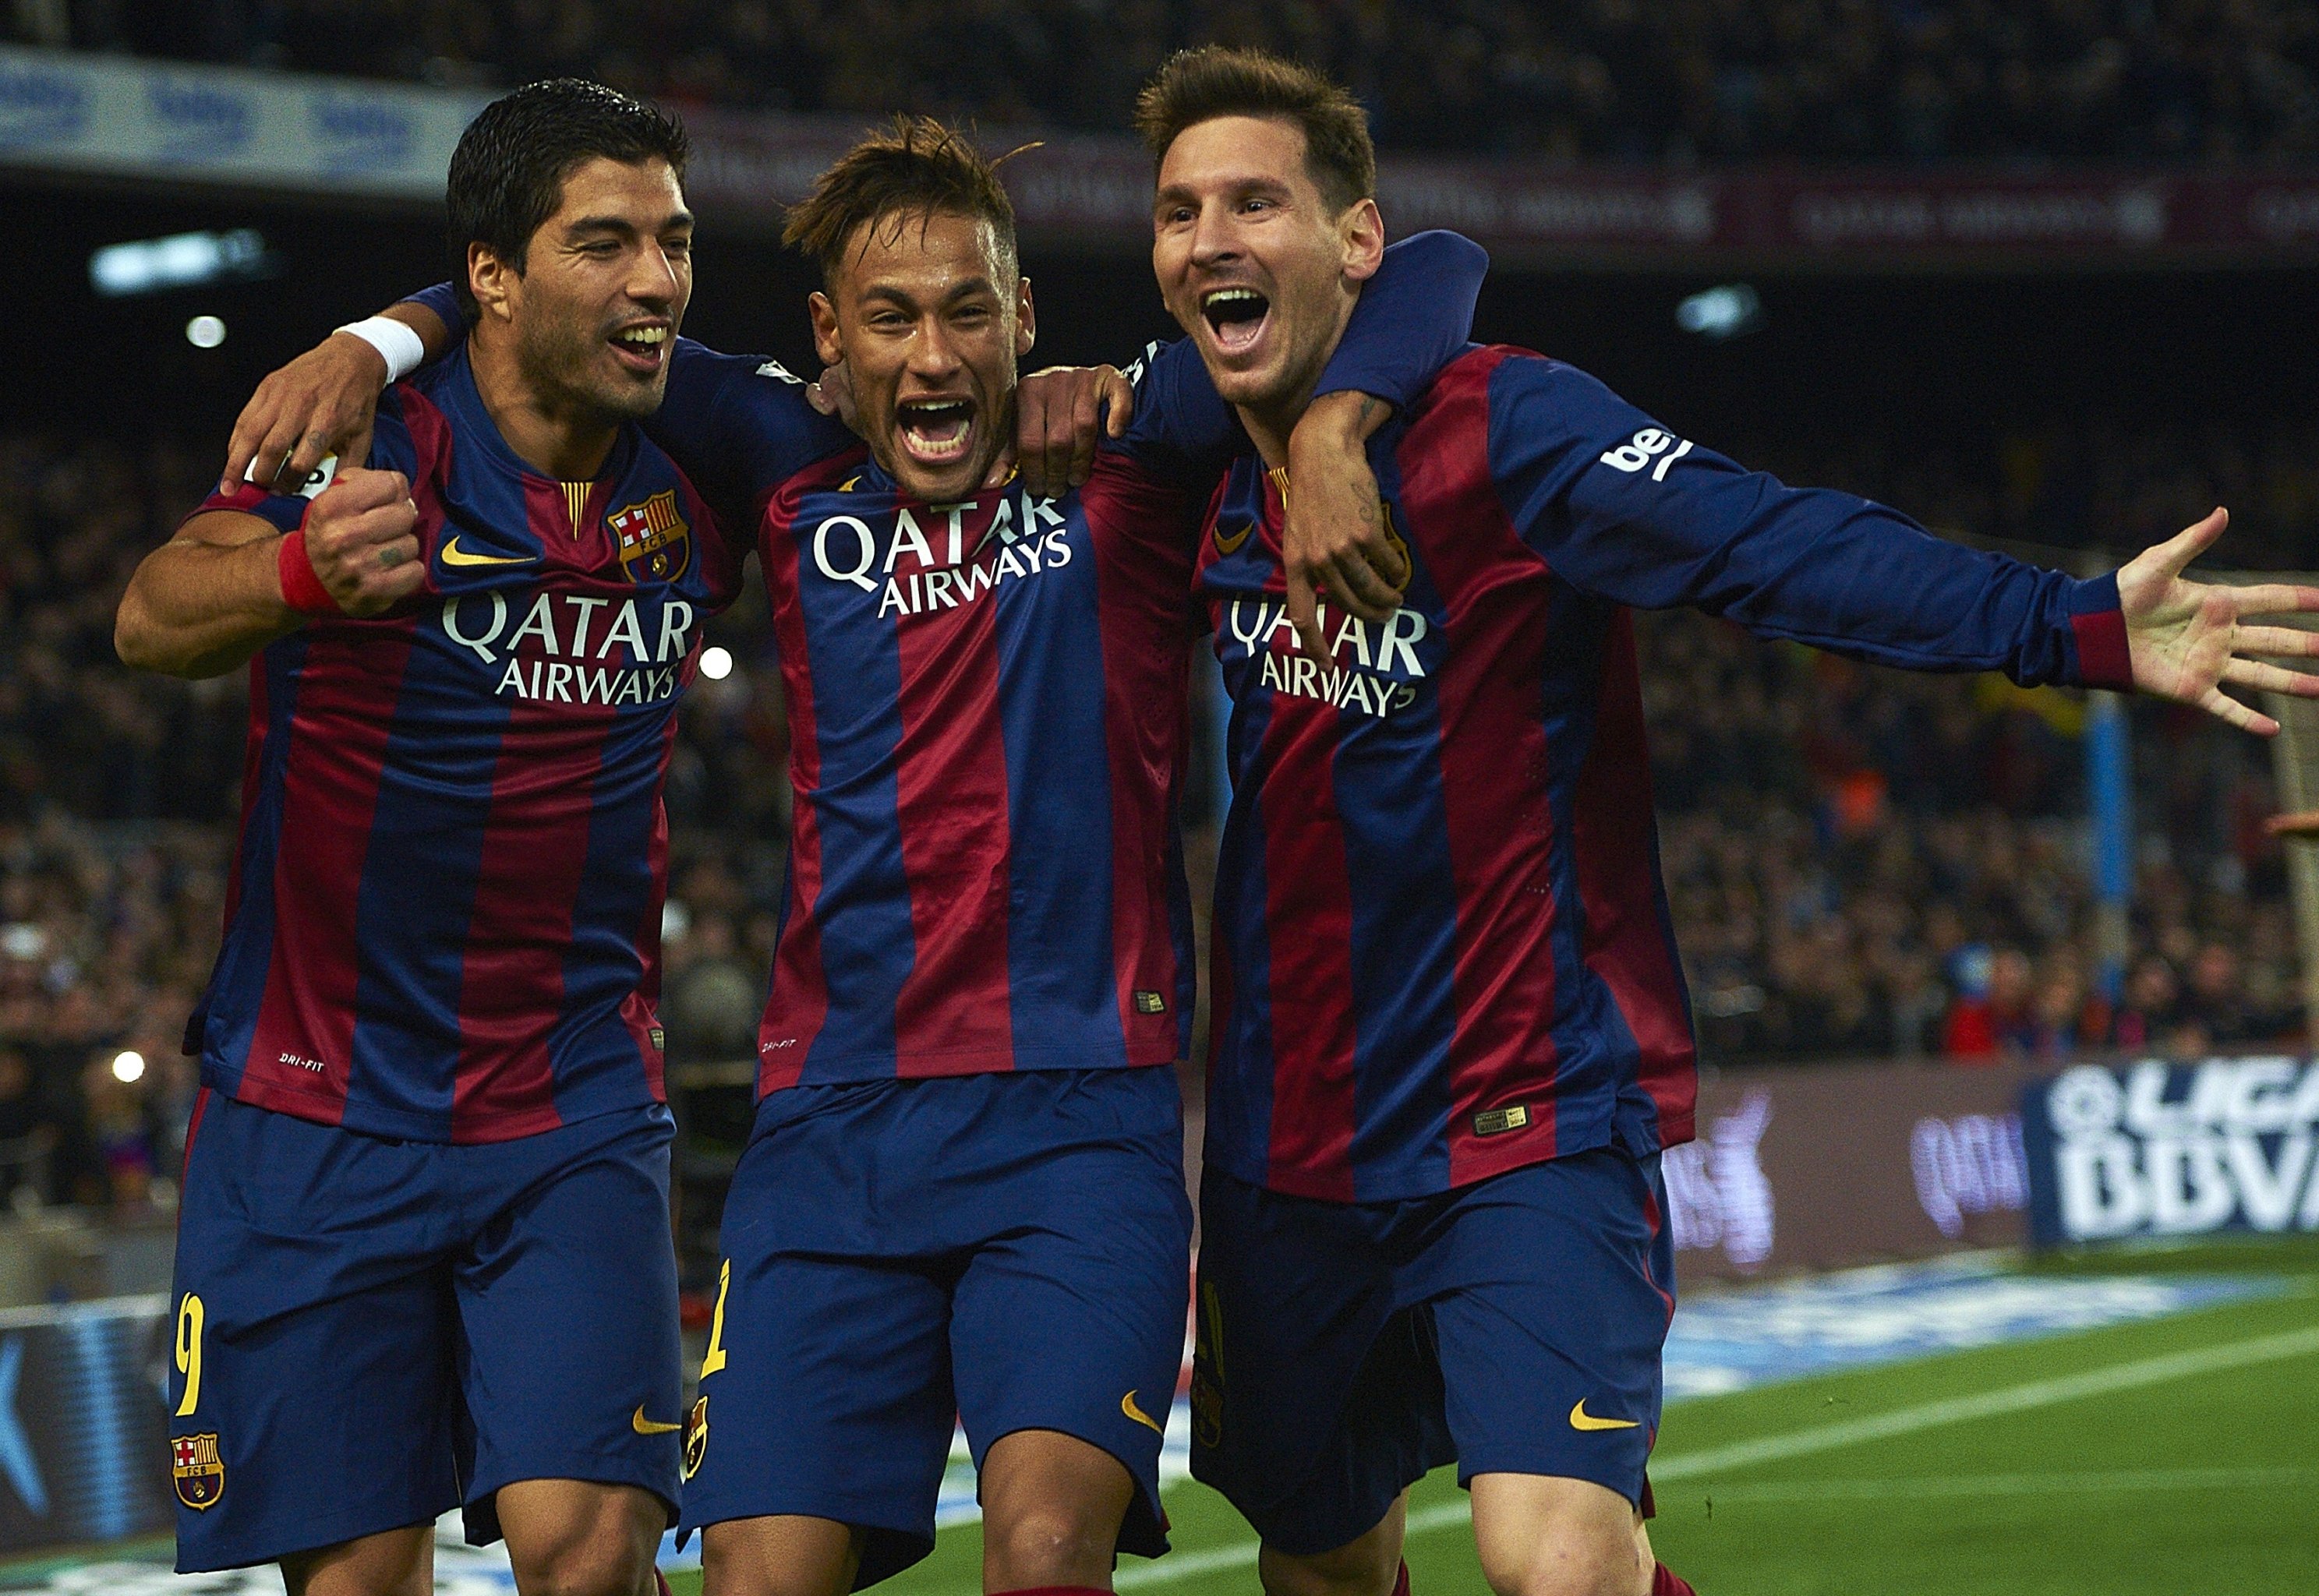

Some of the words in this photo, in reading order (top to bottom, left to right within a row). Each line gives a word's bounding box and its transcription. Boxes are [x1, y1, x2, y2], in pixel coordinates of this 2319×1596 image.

[1600, 428, 1677, 474] be
[639, 532, 667, 553] FCB
[813, 489, 1066, 593] QATAR
[878, 529, 1072, 619] AIRWAYS
[441, 589, 692, 665] QATAR
[494, 658, 679, 705] AIRWAYS
[1260, 650, 1416, 719] AIRWAYS
[278, 1053, 324, 1072] DRI-FIT
[175, 1291, 204, 1417] 9
[186, 1465, 207, 1477] FCB
